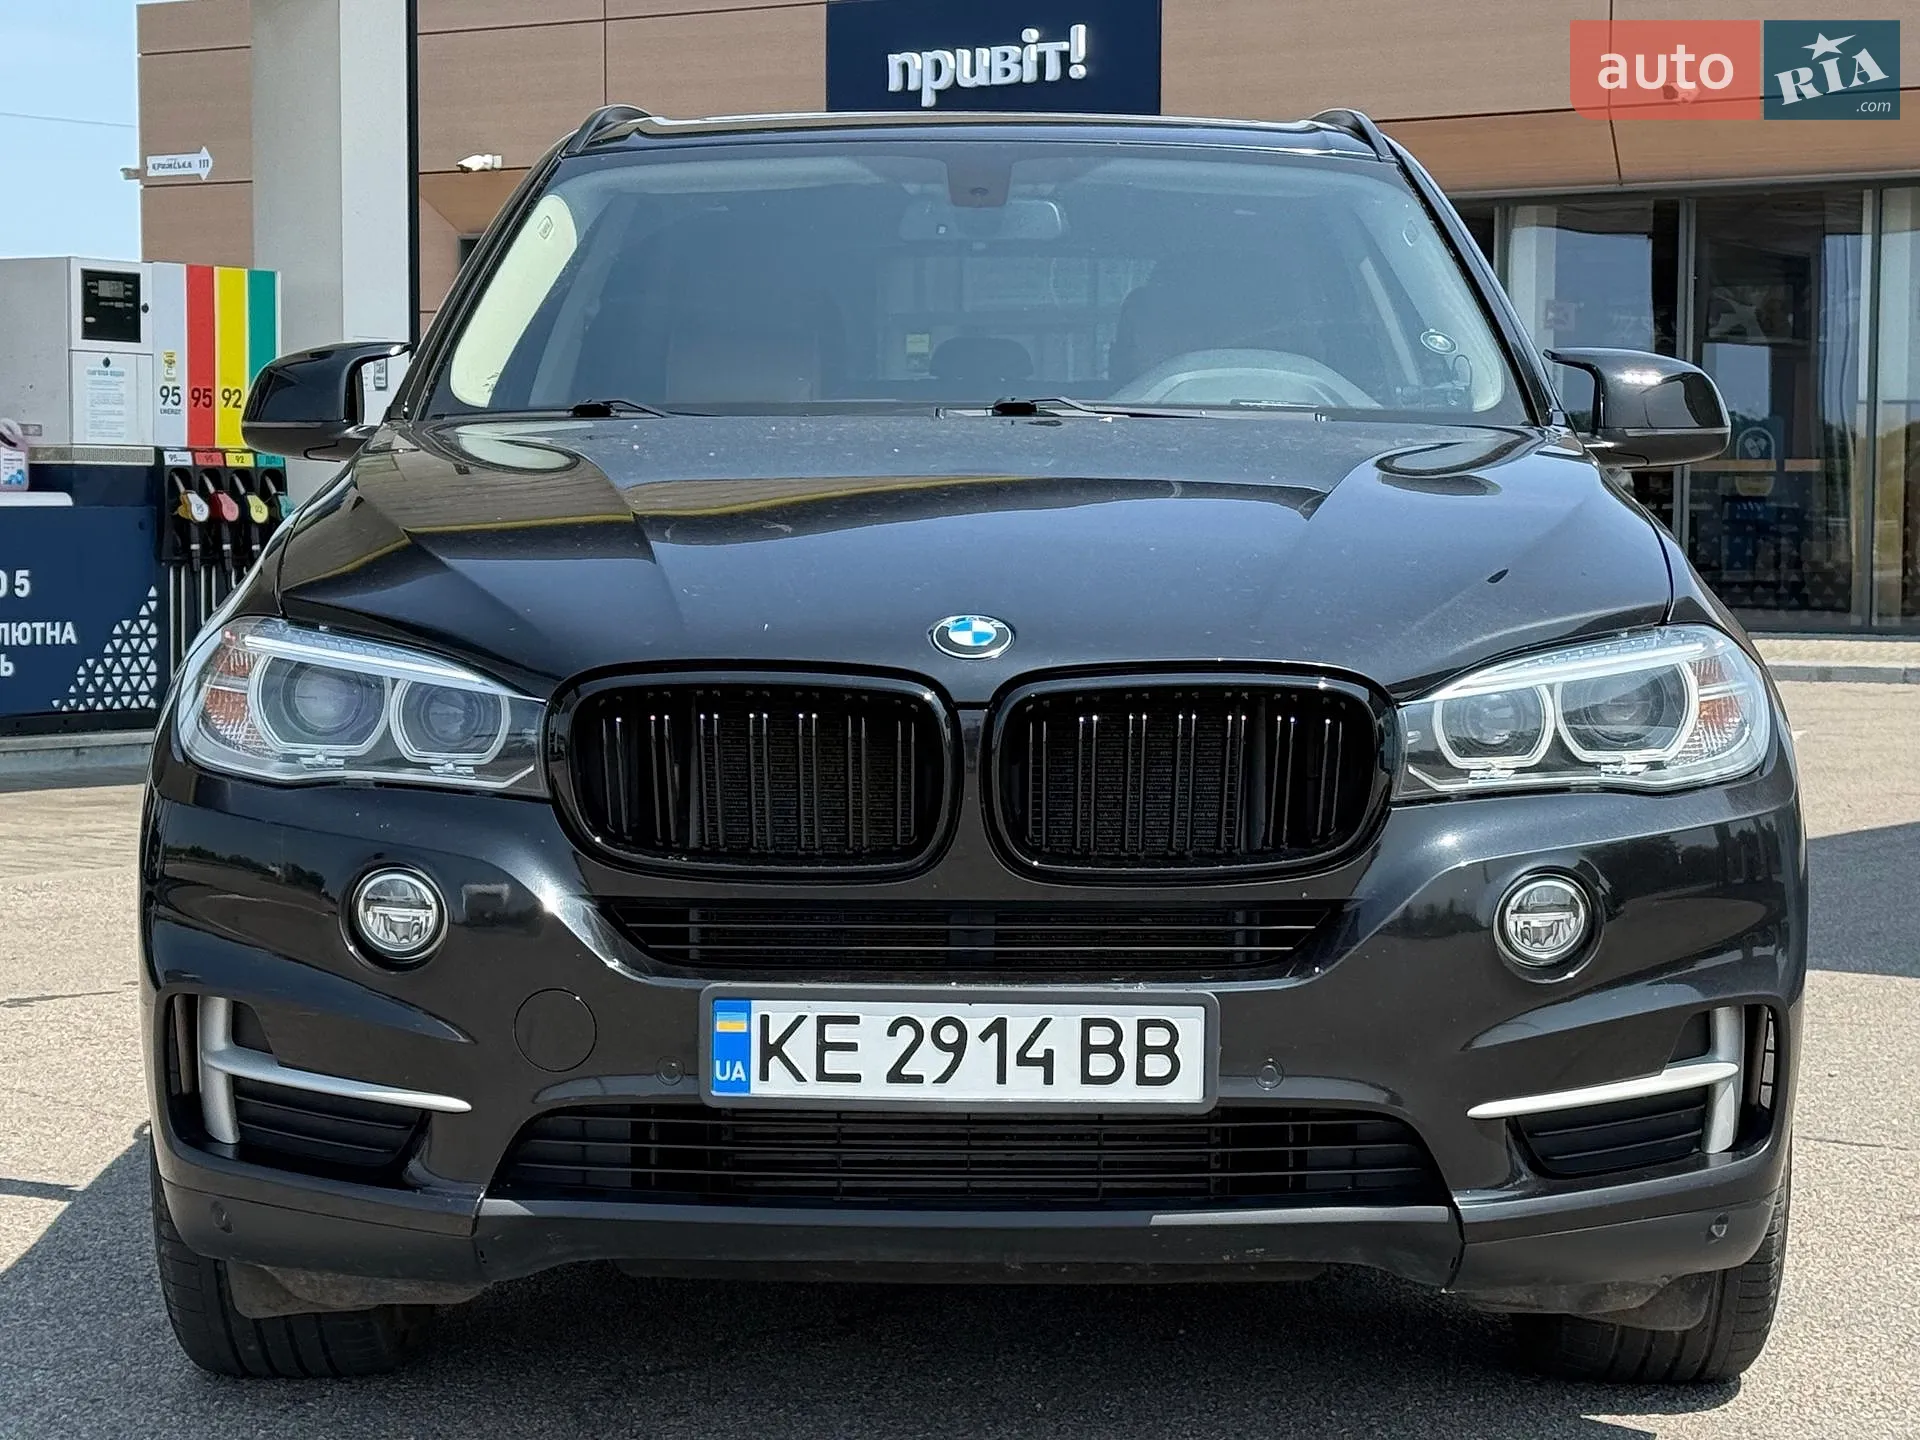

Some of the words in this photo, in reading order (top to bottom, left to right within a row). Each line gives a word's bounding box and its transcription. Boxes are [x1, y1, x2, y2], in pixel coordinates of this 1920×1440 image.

[887, 24, 1088, 108] привіт!
[159, 385, 182, 406] 95
[191, 387, 213, 409] 95
[221, 388, 242, 409] 92
[235, 455, 245, 464] 92
[758, 1013, 862, 1084] KE
[885, 1015, 1055, 1086] 2914
[1080, 1016, 1182, 1087] BB
[714, 1059, 747, 1082] UA
